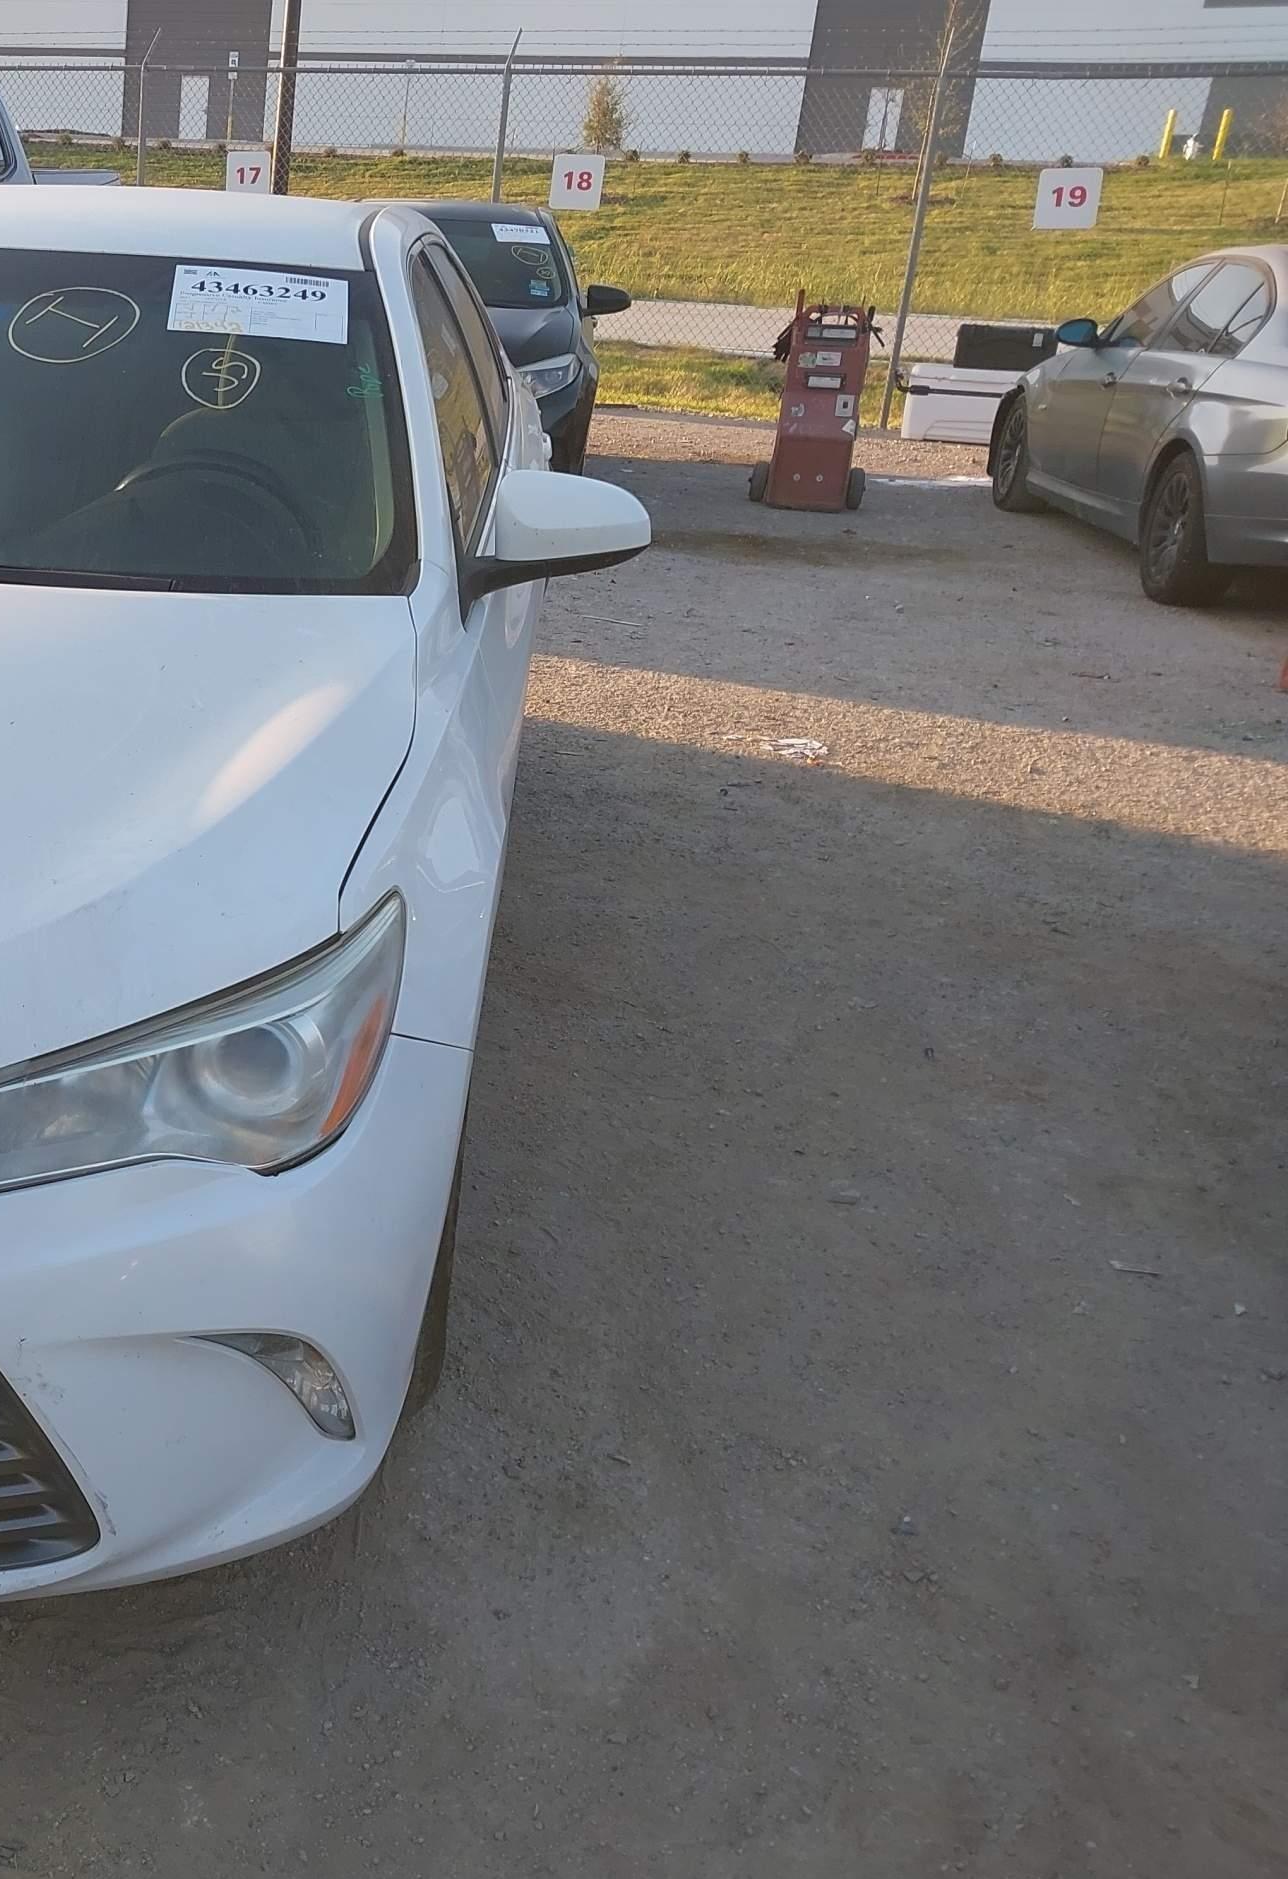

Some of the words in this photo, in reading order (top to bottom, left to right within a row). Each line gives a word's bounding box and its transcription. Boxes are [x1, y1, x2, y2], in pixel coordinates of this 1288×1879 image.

[236, 167, 262, 185] 17
[563, 171, 593, 191] 18
[1052, 185, 1088, 208] 19
[191, 279, 327, 302] 43463249
